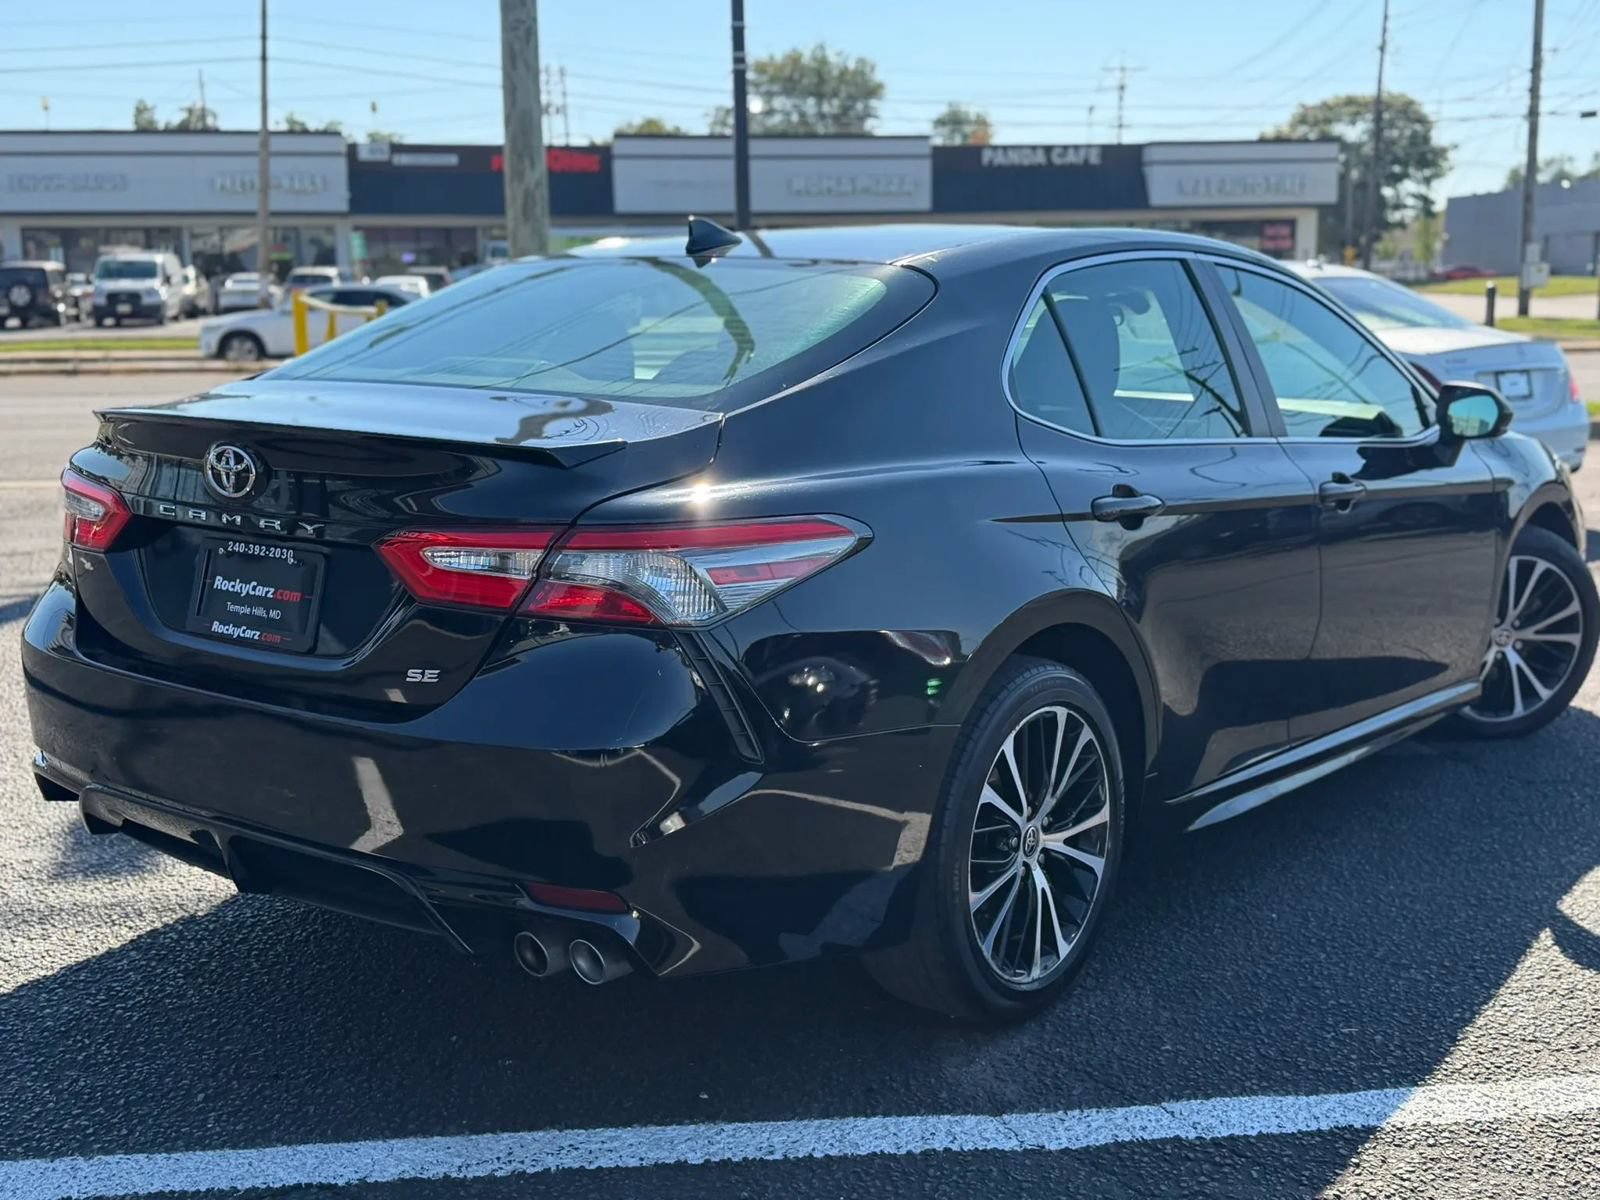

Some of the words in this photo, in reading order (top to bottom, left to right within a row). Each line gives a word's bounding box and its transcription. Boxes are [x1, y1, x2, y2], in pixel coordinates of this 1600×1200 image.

[981, 147, 1047, 167] PANDA
[1051, 146, 1102, 166] CAFE
[159, 504, 324, 534] CAMRY
[213, 575, 302, 602] RockyCarz.com
[226, 601, 251, 616] Temple
[251, 605, 268, 619] Hills,
[268, 608, 281, 620] MD
[405, 668, 440, 682] SE
